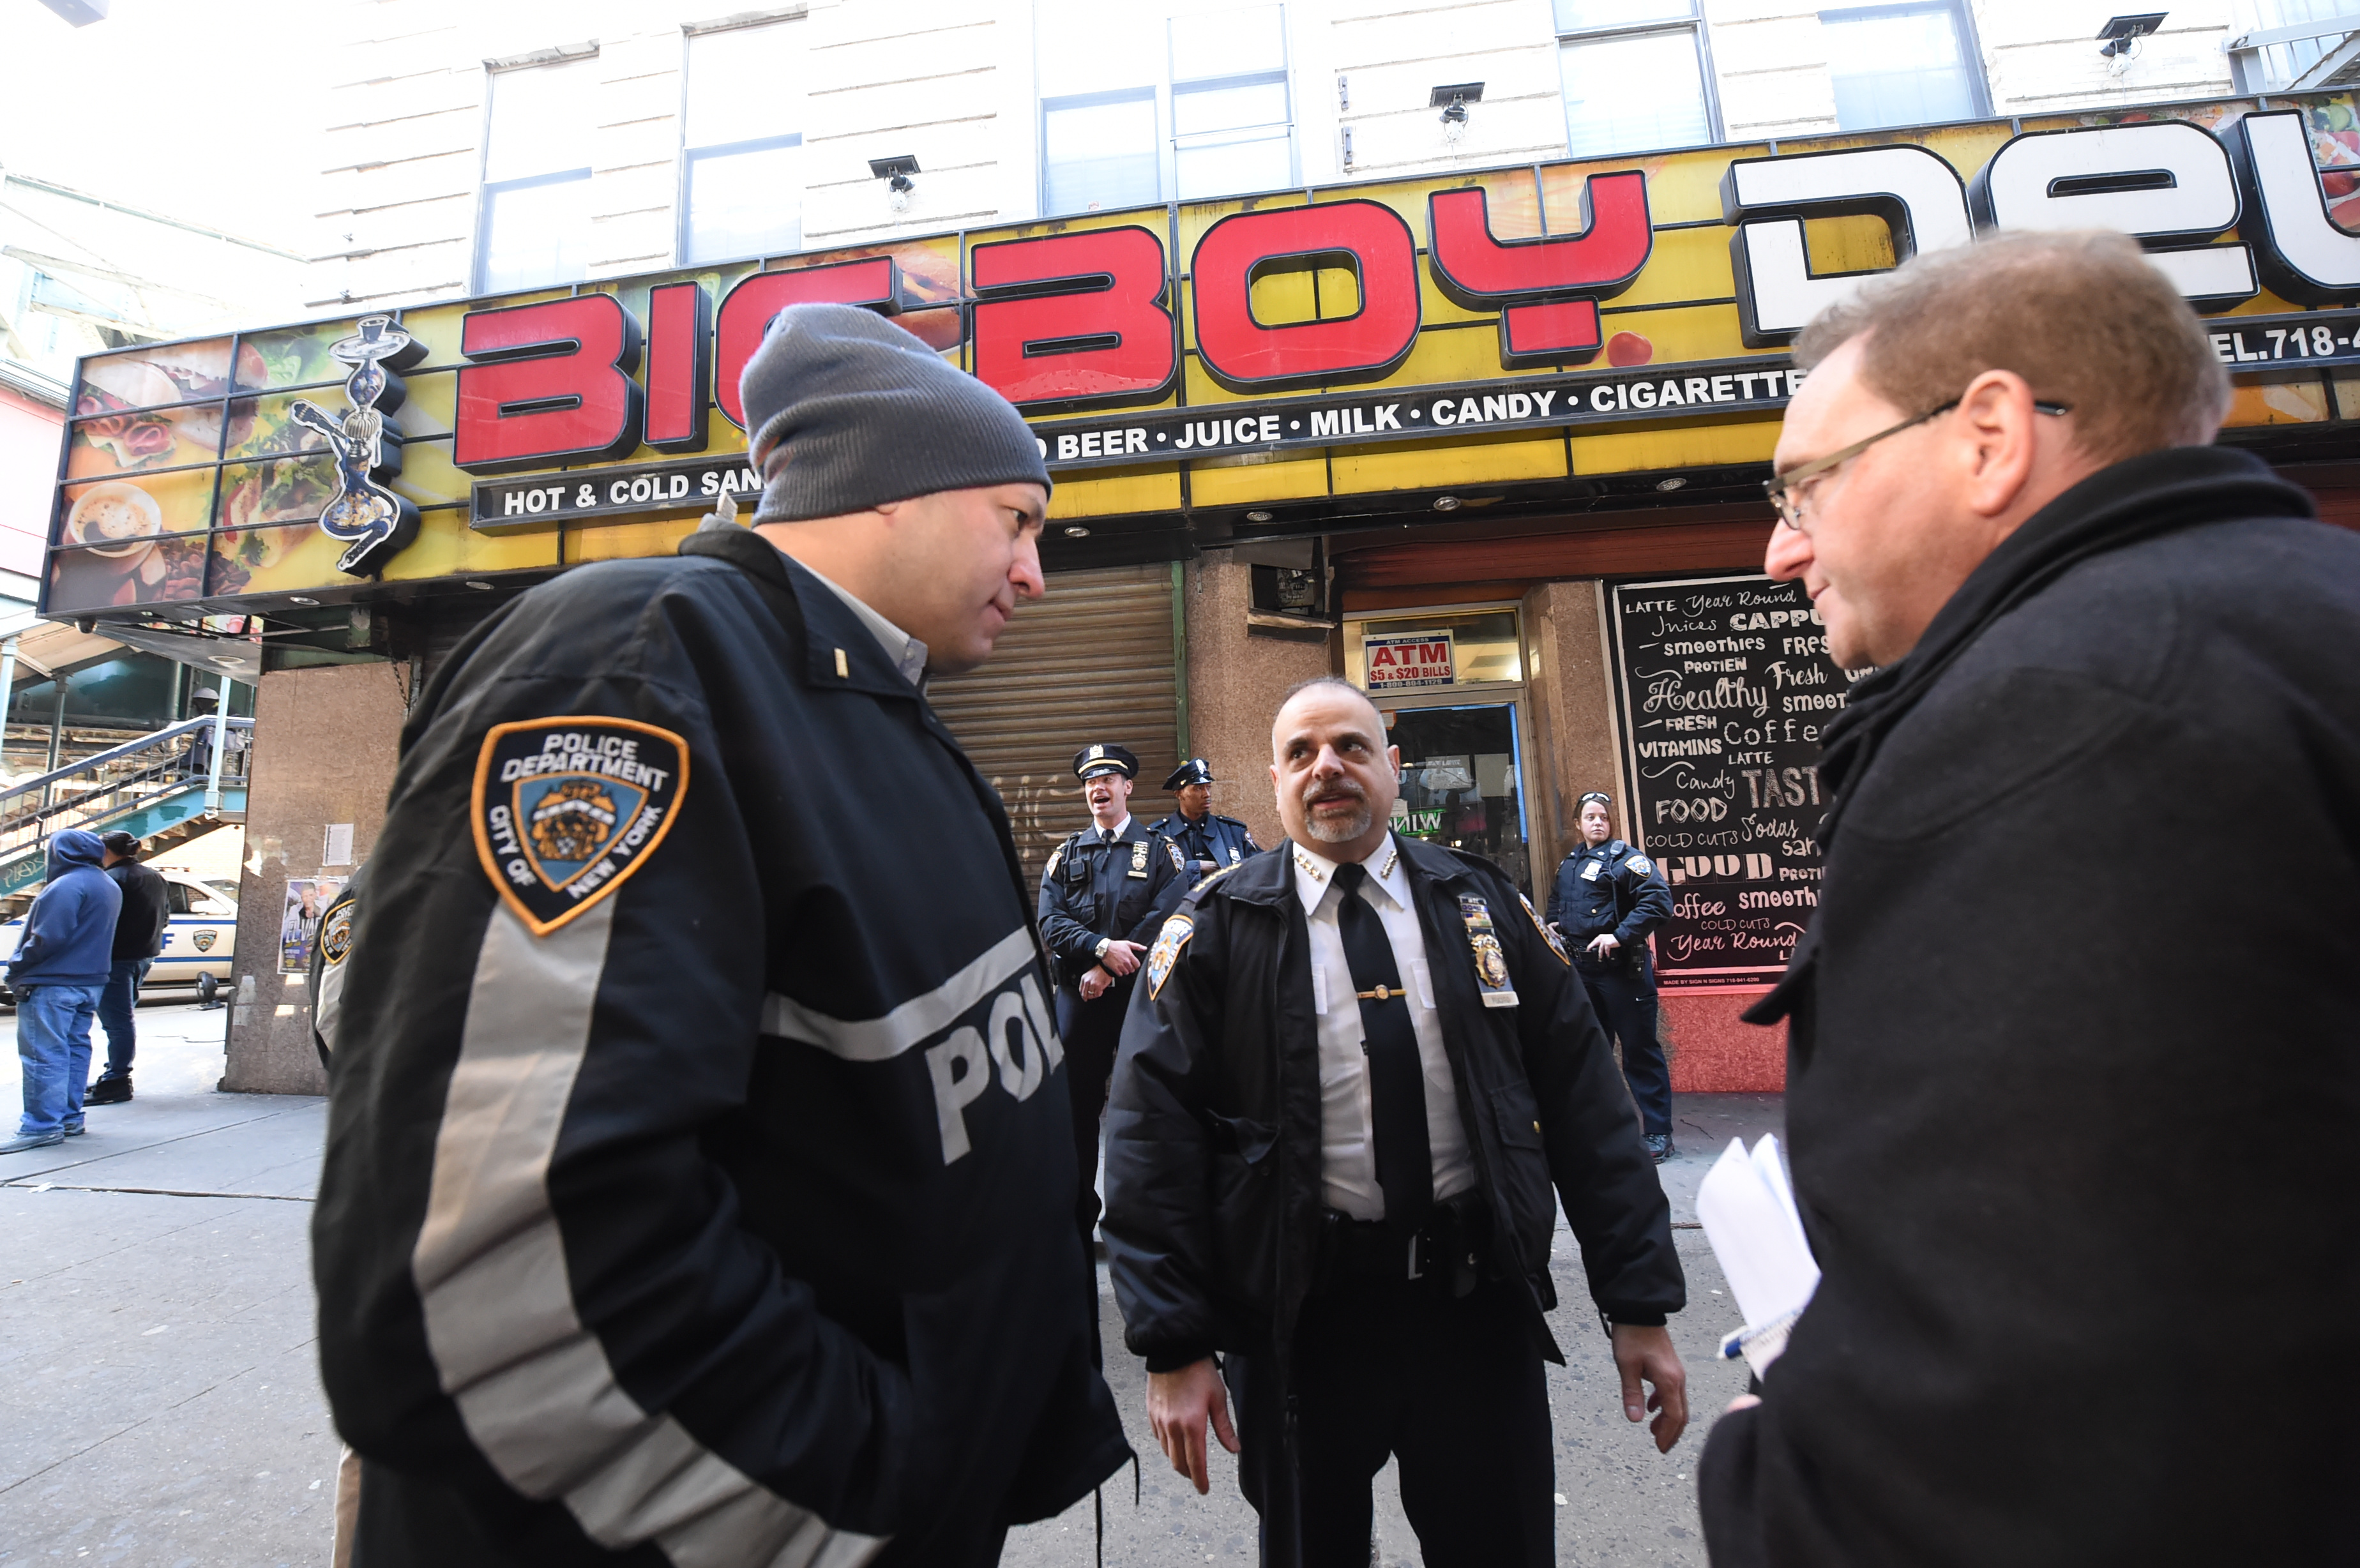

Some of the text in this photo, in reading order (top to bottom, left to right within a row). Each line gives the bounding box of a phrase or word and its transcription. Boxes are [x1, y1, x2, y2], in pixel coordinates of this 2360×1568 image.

[969, 169, 1654, 403] BOY
[1058, 428, 1149, 460] BEER
[1175, 414, 1280, 449] JUICE
[1311, 403, 1401, 436] MILK
[1431, 391, 1556, 426] CANDY
[504, 468, 768, 515] HOT & COLD SAN
[1626, 589, 1796, 617] LATTE Year Round
[1372, 643, 1447, 667] ATM
[1370, 669, 1384, 681] $5
[1396, 667, 1419, 680] $20
[1423, 666, 1450, 677] BILLS
[1684, 657, 1747, 674] PROTIEN
[1765, 661, 1828, 690] Fresh
[1644, 676, 1770, 718] Healthy
[1666, 715, 1718, 732] FRESH
[543, 733, 639, 760] POLICE
[1639, 738, 1722, 758] VITAMINS
[1728, 751, 1774, 765] LATTE
[500, 753, 669, 792] DEPARTMENT
[1676, 769, 1735, 799] Candy
[1656, 797, 1727, 824] FOOD
[1646, 813, 1799, 848] COLD CUTS Sodas
[489, 804, 664, 899] CITY OF NEW YORK
[1656, 854, 1773, 886] GOOD
[1672, 893, 1726, 919] offee
[1701, 918, 1770, 931] COLD CUTS
[1667, 931, 1797, 961] Year Round
